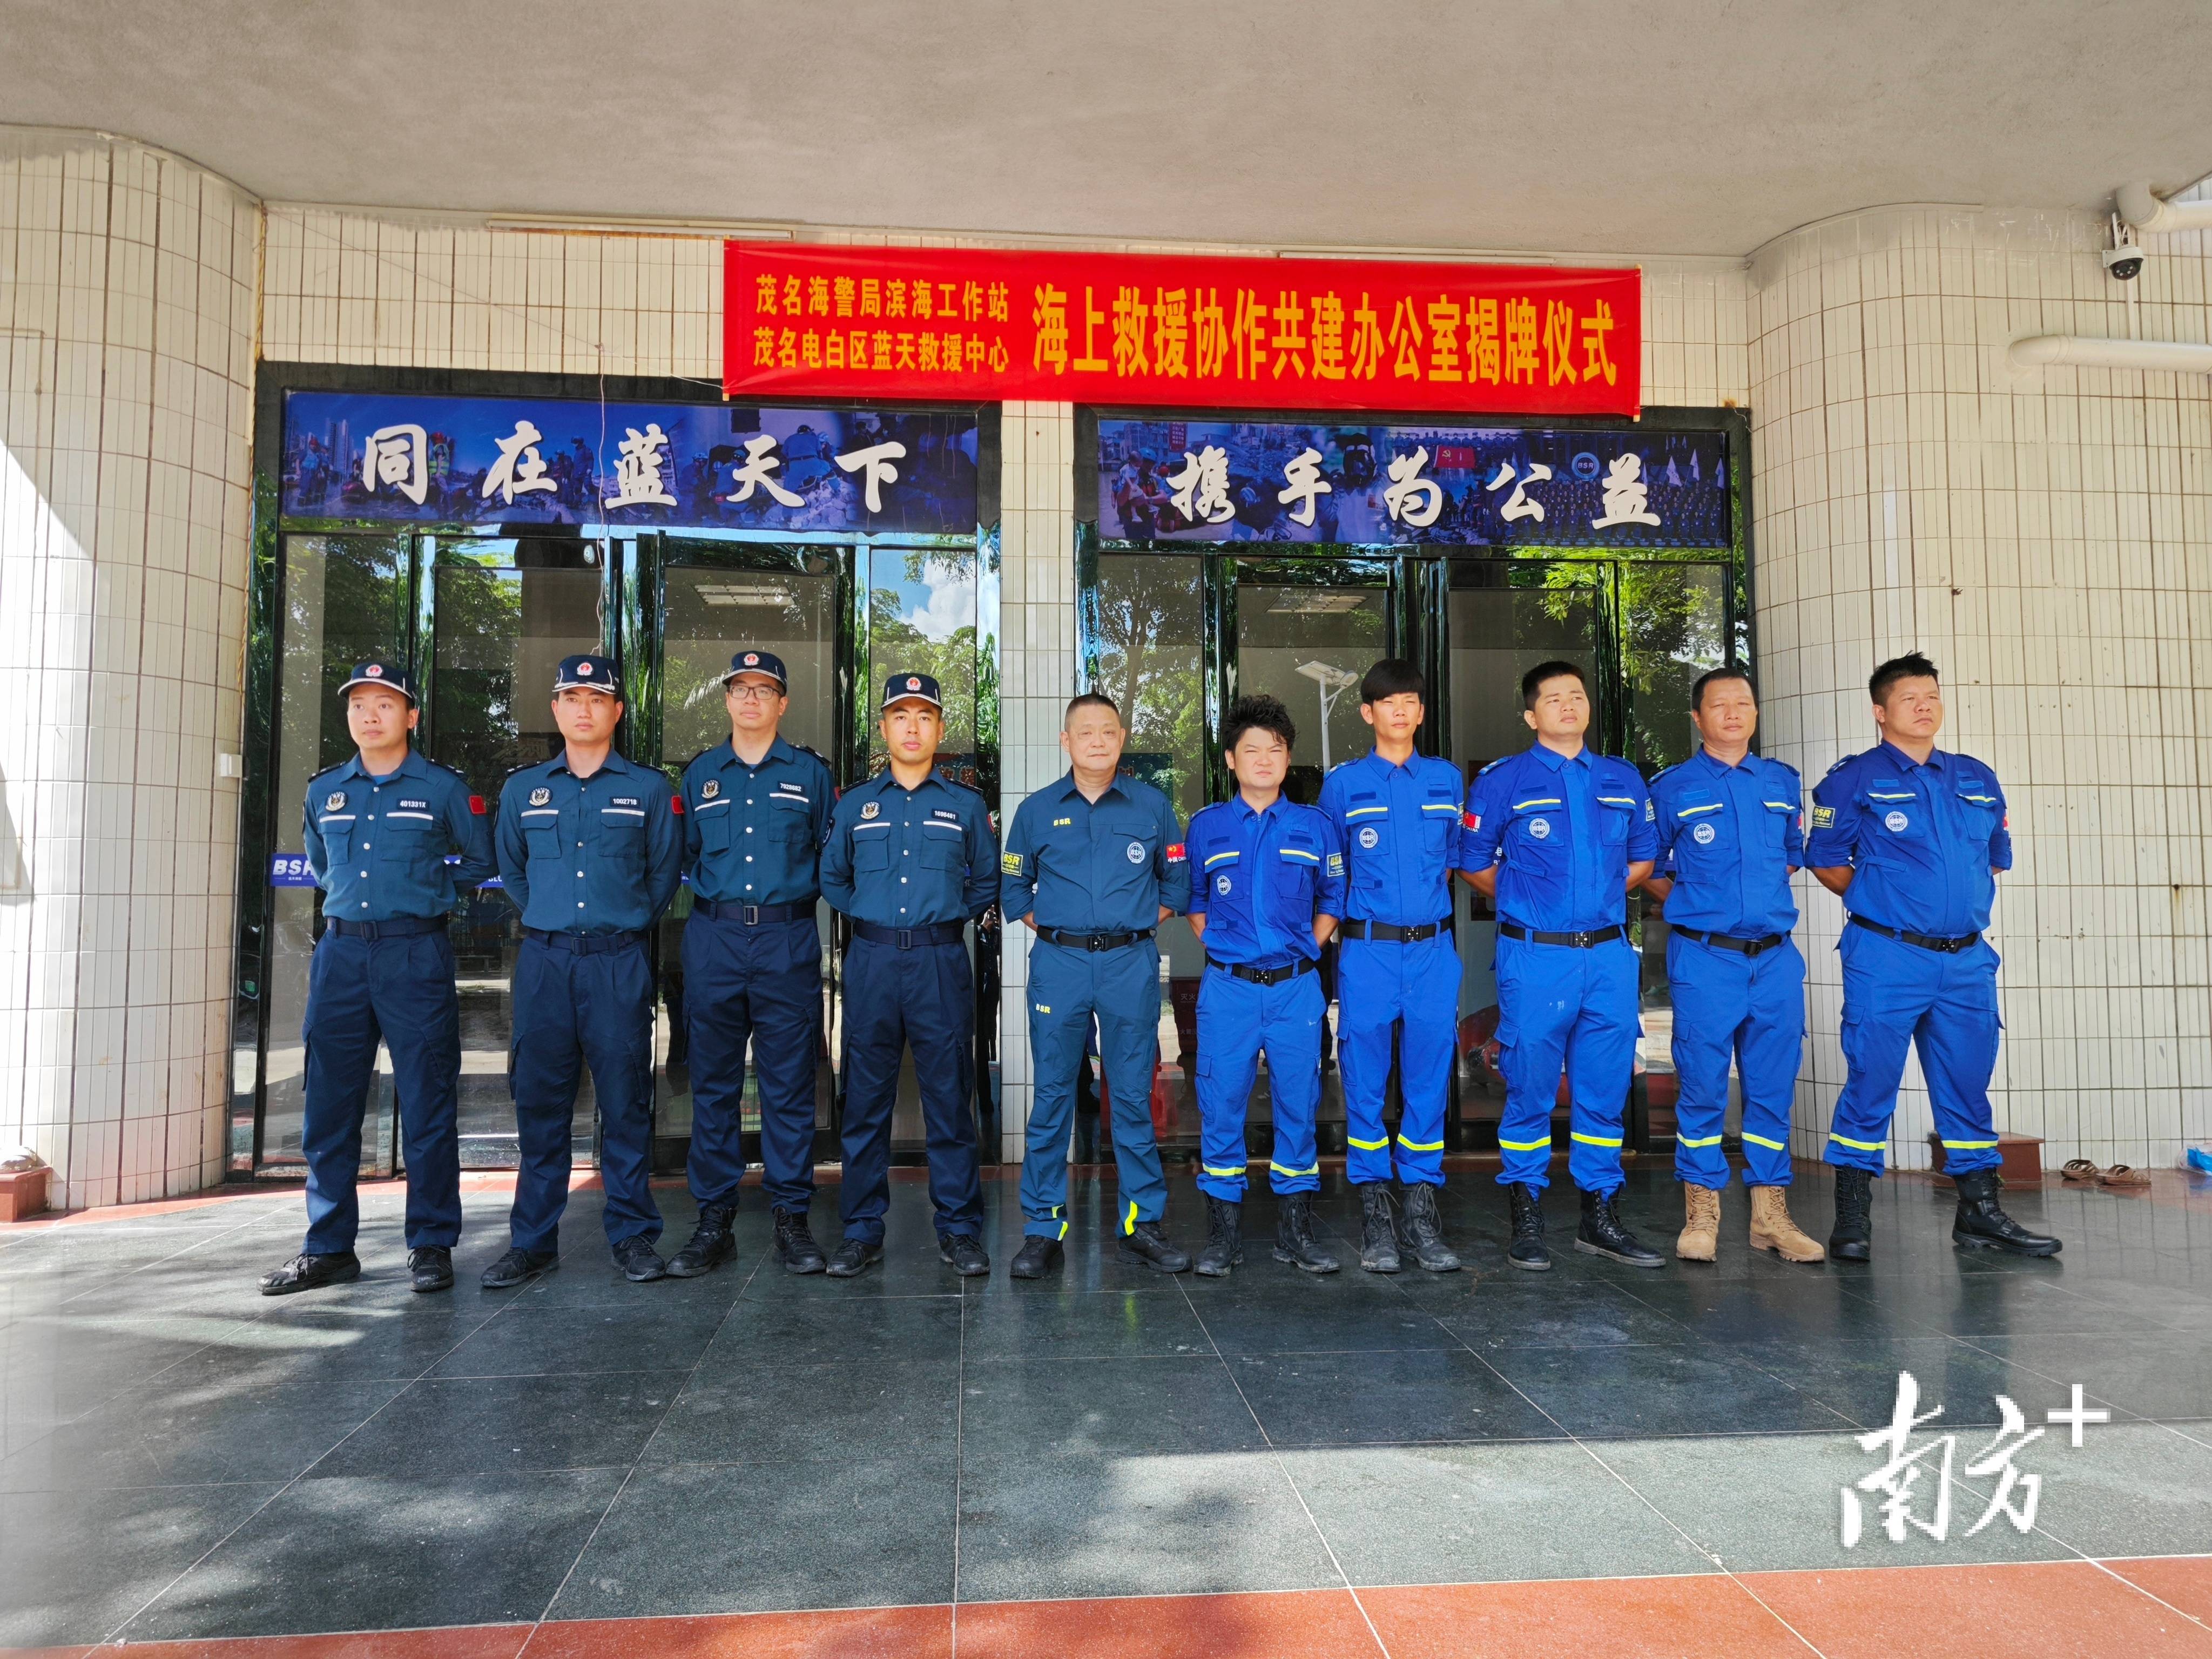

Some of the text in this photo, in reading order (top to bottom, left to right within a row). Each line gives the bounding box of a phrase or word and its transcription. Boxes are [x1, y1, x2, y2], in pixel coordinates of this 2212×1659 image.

[756, 275, 1008, 320] 茂名海警局滨海工作站
[1032, 282, 1616, 386] 海上救援协作共建办公室揭牌仪式
[753, 327, 1008, 372] 茂名电白区蓝天救援中心
[361, 420, 906, 512] 同在蓝天下
[1165, 444, 1660, 529] 携手为公益
[400, 800, 426, 808] 401331X
[1814, 807, 1831, 818] BSR
[1053, 818, 1071, 826] BSR
[1003, 853, 1020, 866] BSR
[1036, 1003, 1051, 1014] BSR
